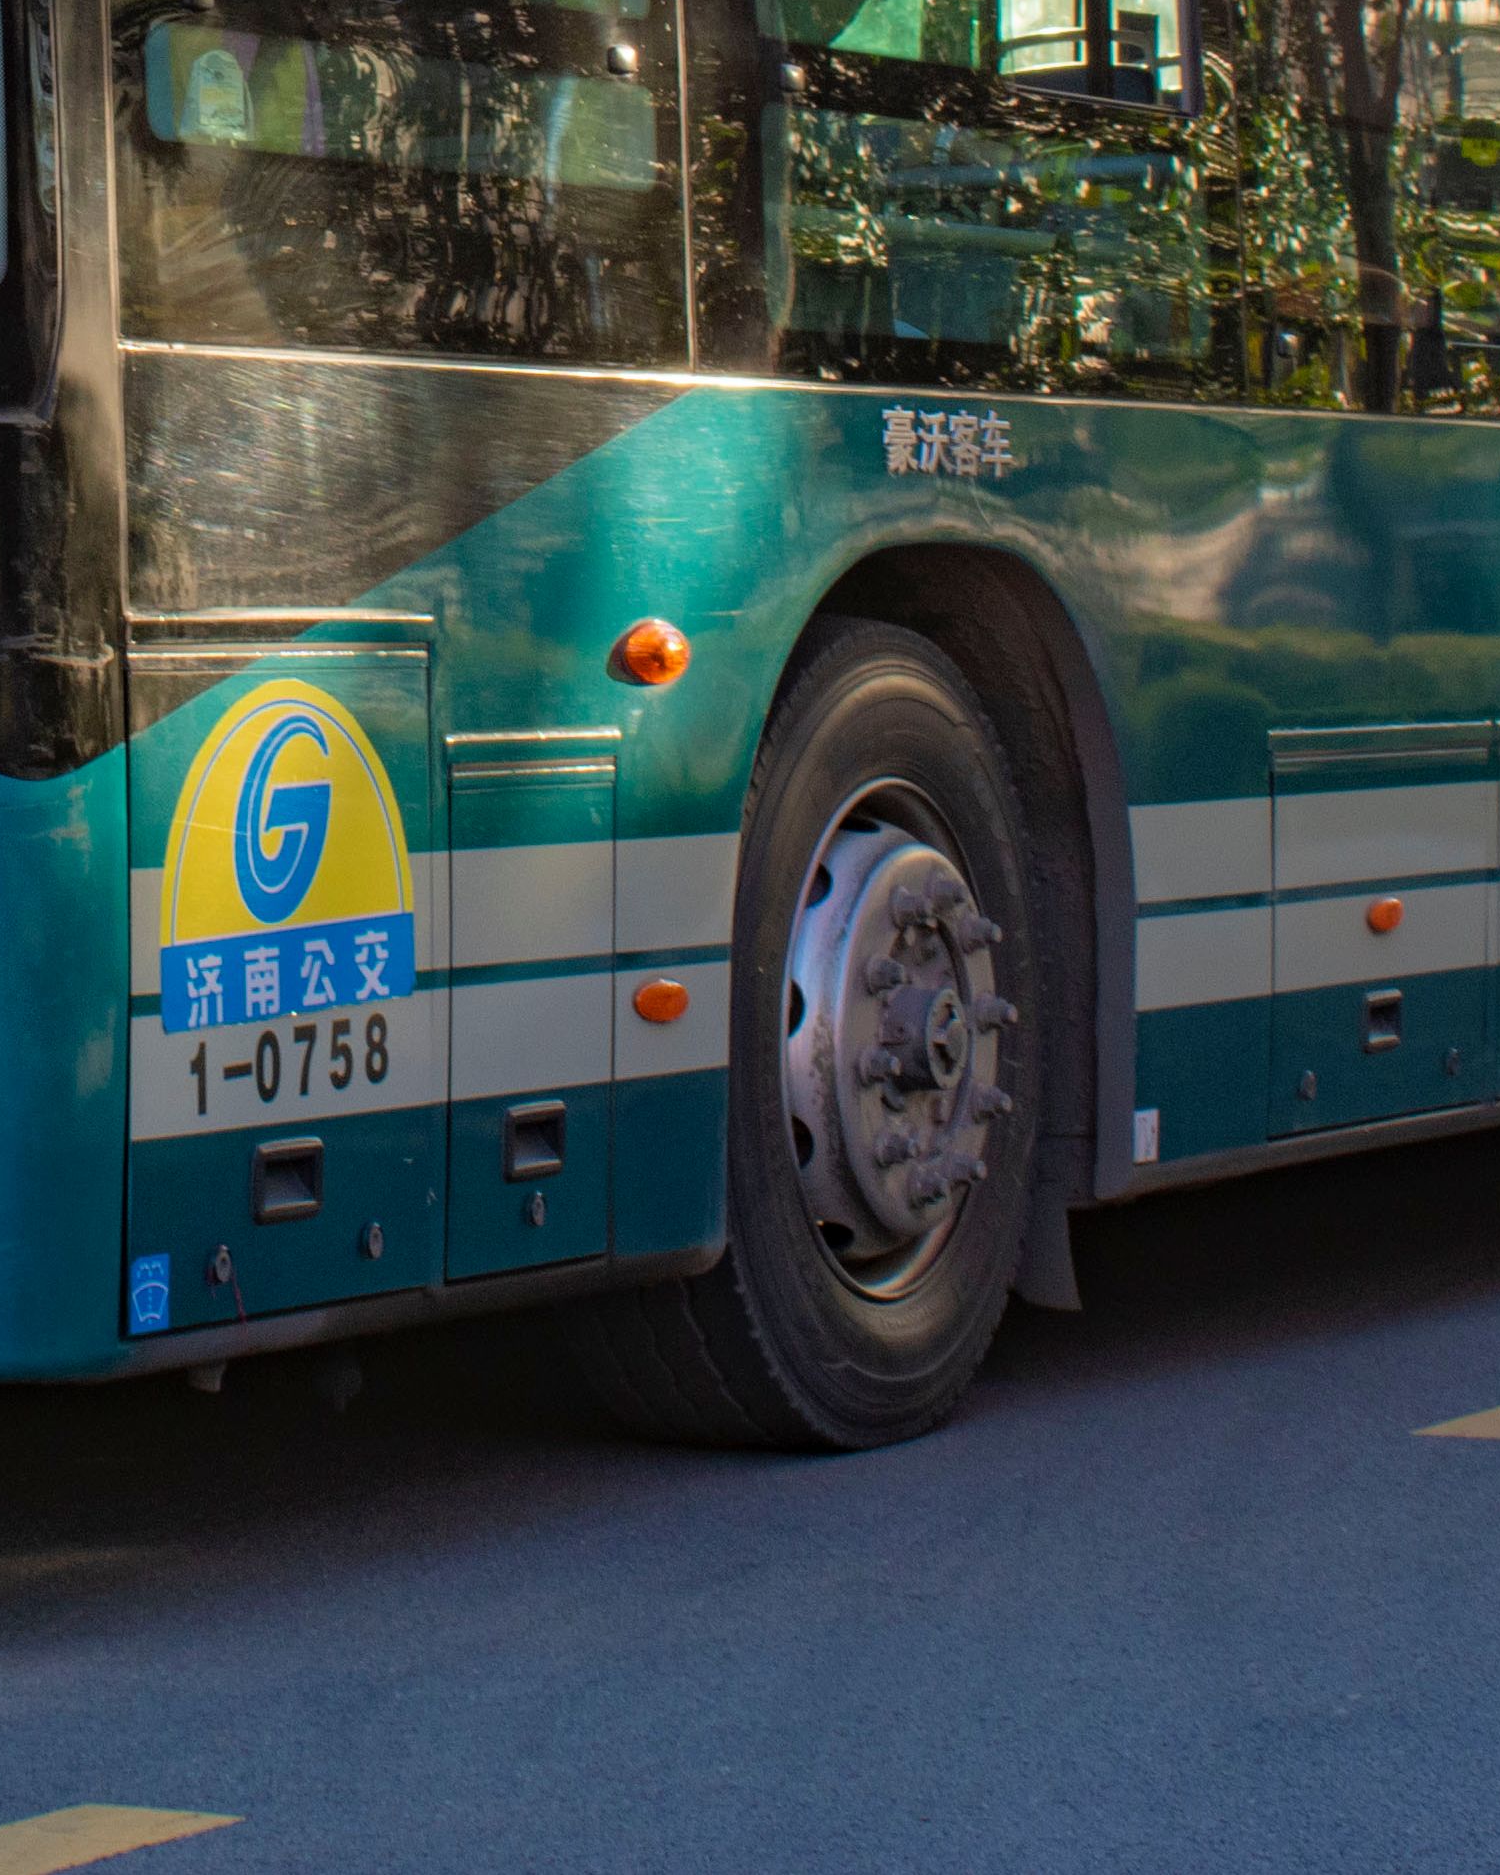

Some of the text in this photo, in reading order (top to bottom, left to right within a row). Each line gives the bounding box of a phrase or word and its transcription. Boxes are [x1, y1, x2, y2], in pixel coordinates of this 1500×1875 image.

[881, 404, 1015, 477] 豪沃客车
[186, 929, 391, 1029] 济南公交
[189, 1012, 390, 1117] 1-0758
